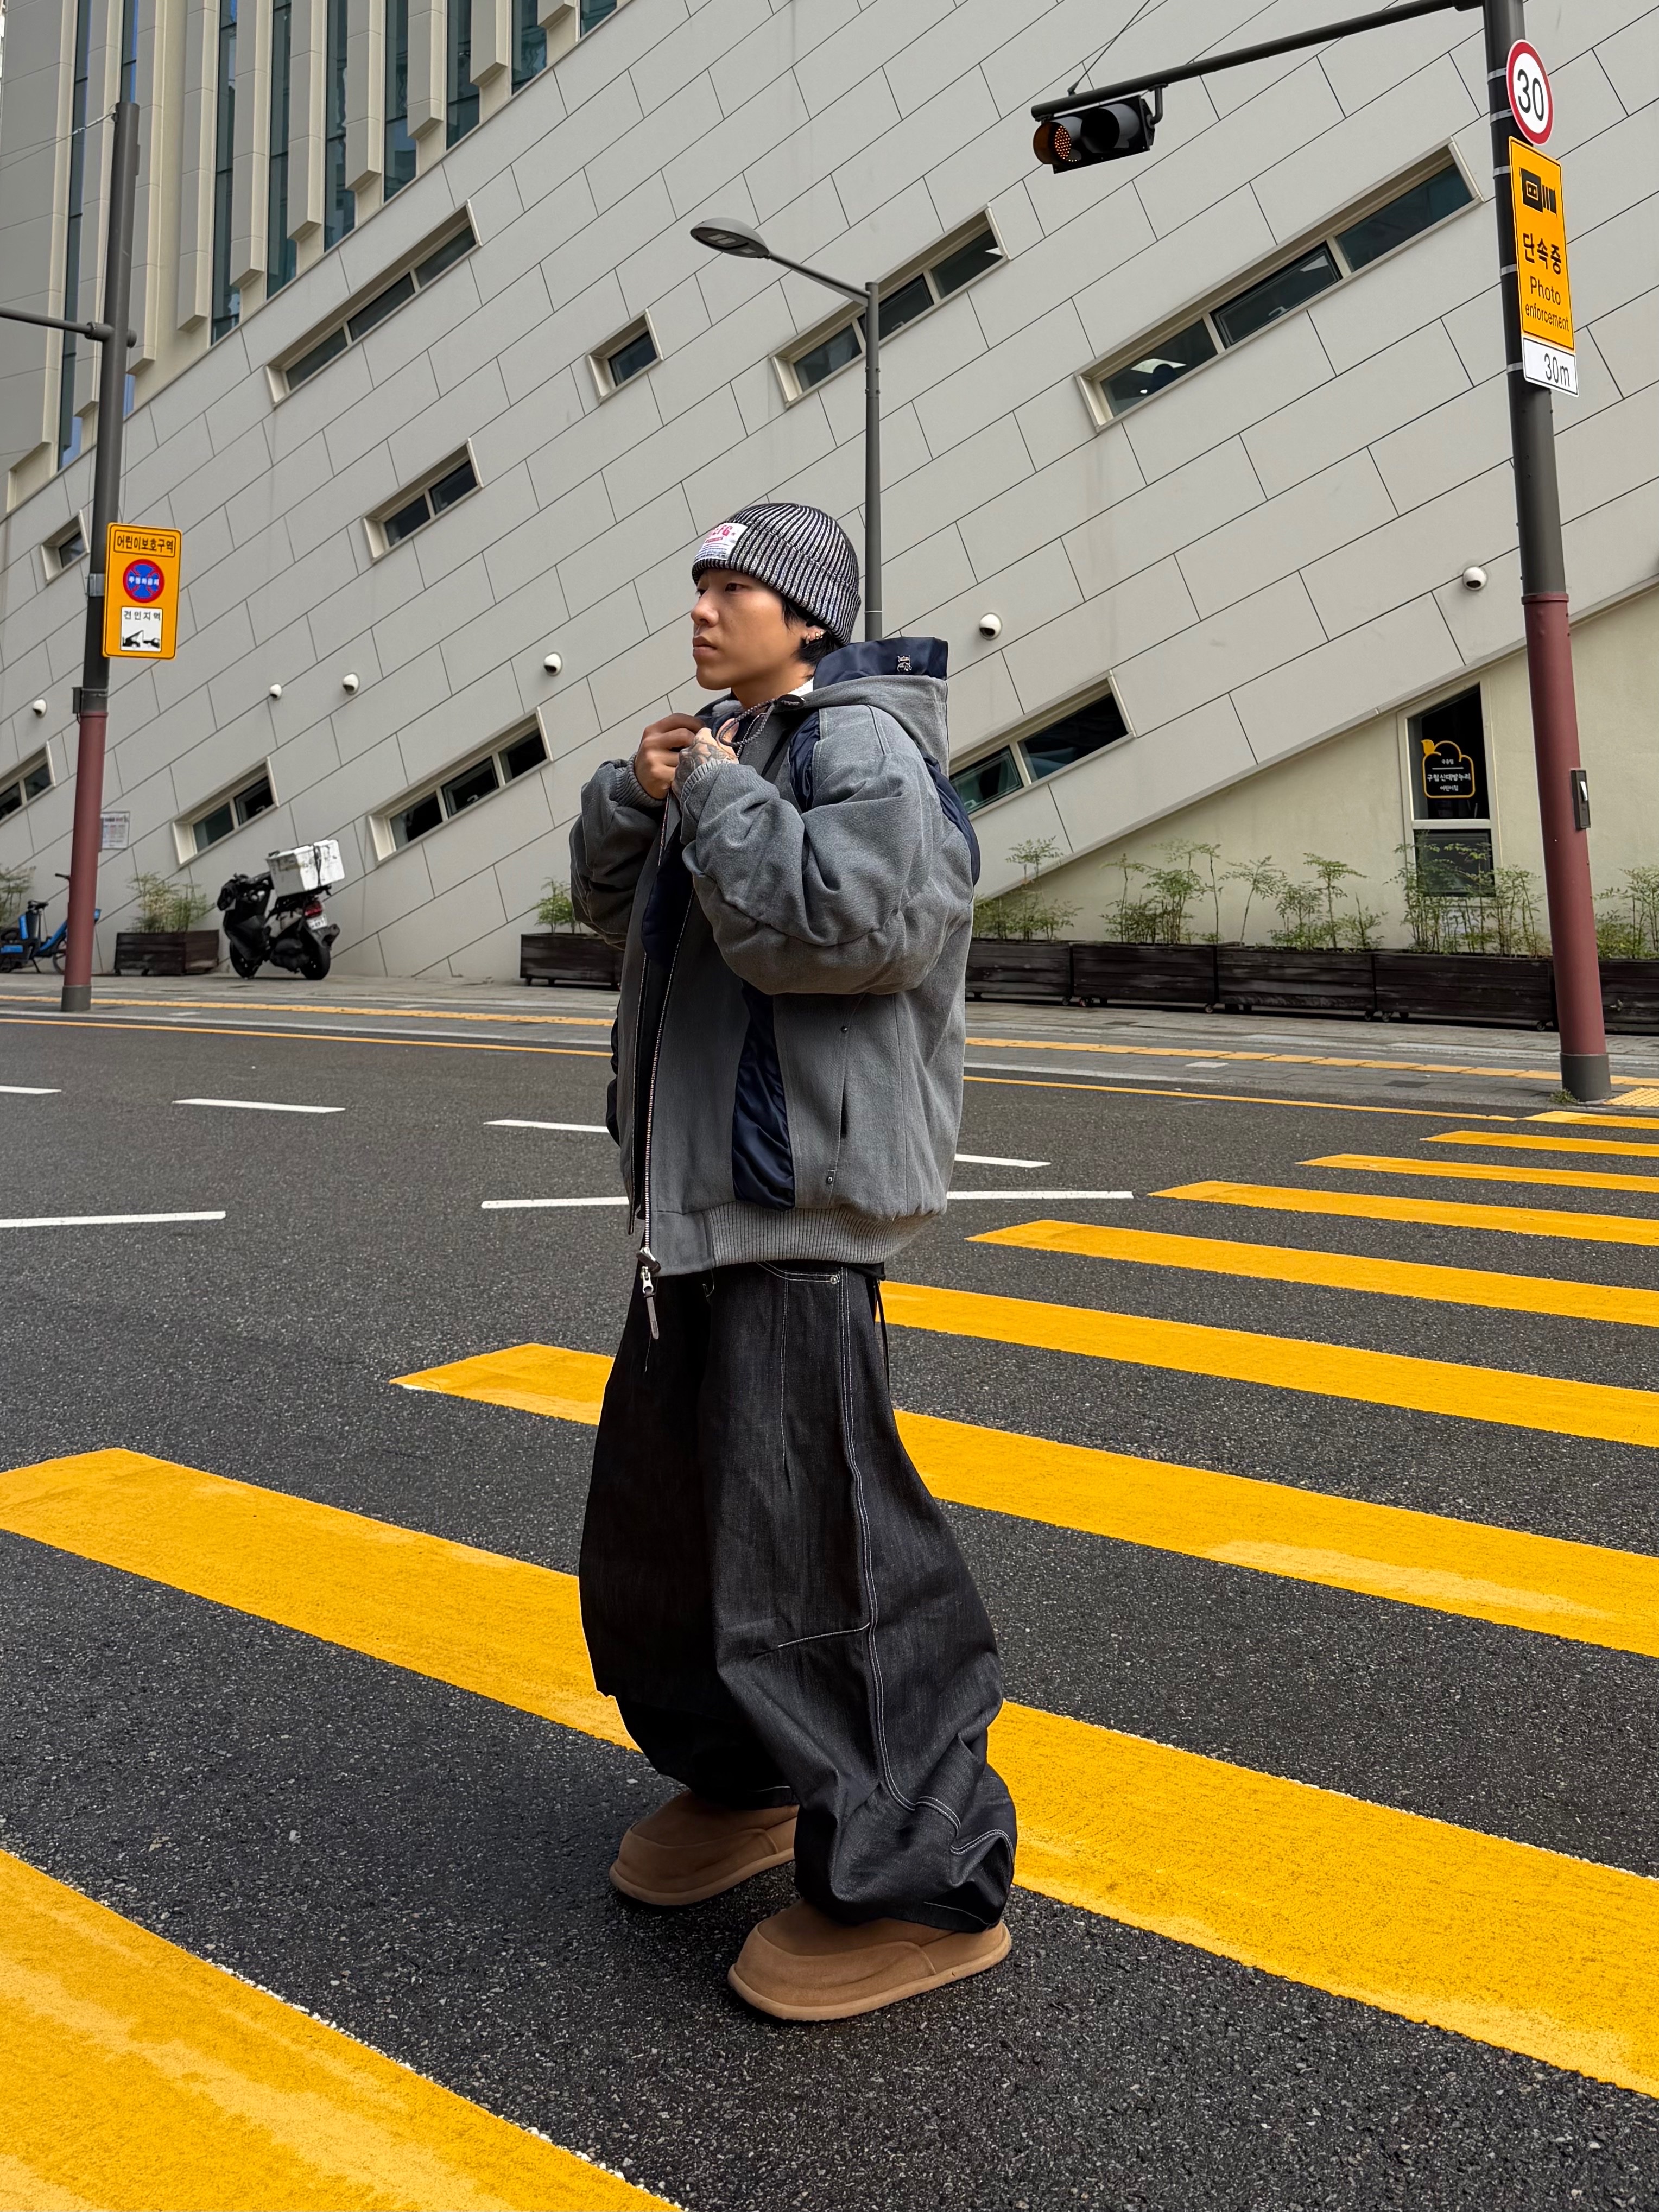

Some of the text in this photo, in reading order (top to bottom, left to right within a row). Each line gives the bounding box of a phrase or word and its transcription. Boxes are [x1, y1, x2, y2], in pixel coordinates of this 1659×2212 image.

[1517, 68, 1544, 121] 30
[1523, 233, 1561, 275] 단속중
[1530, 275, 1561, 305] Photo
[1525, 302, 1569, 331] enforcement
[1544, 353, 1570, 387] 30m
[117, 535, 173, 553] 어린이보호구역
